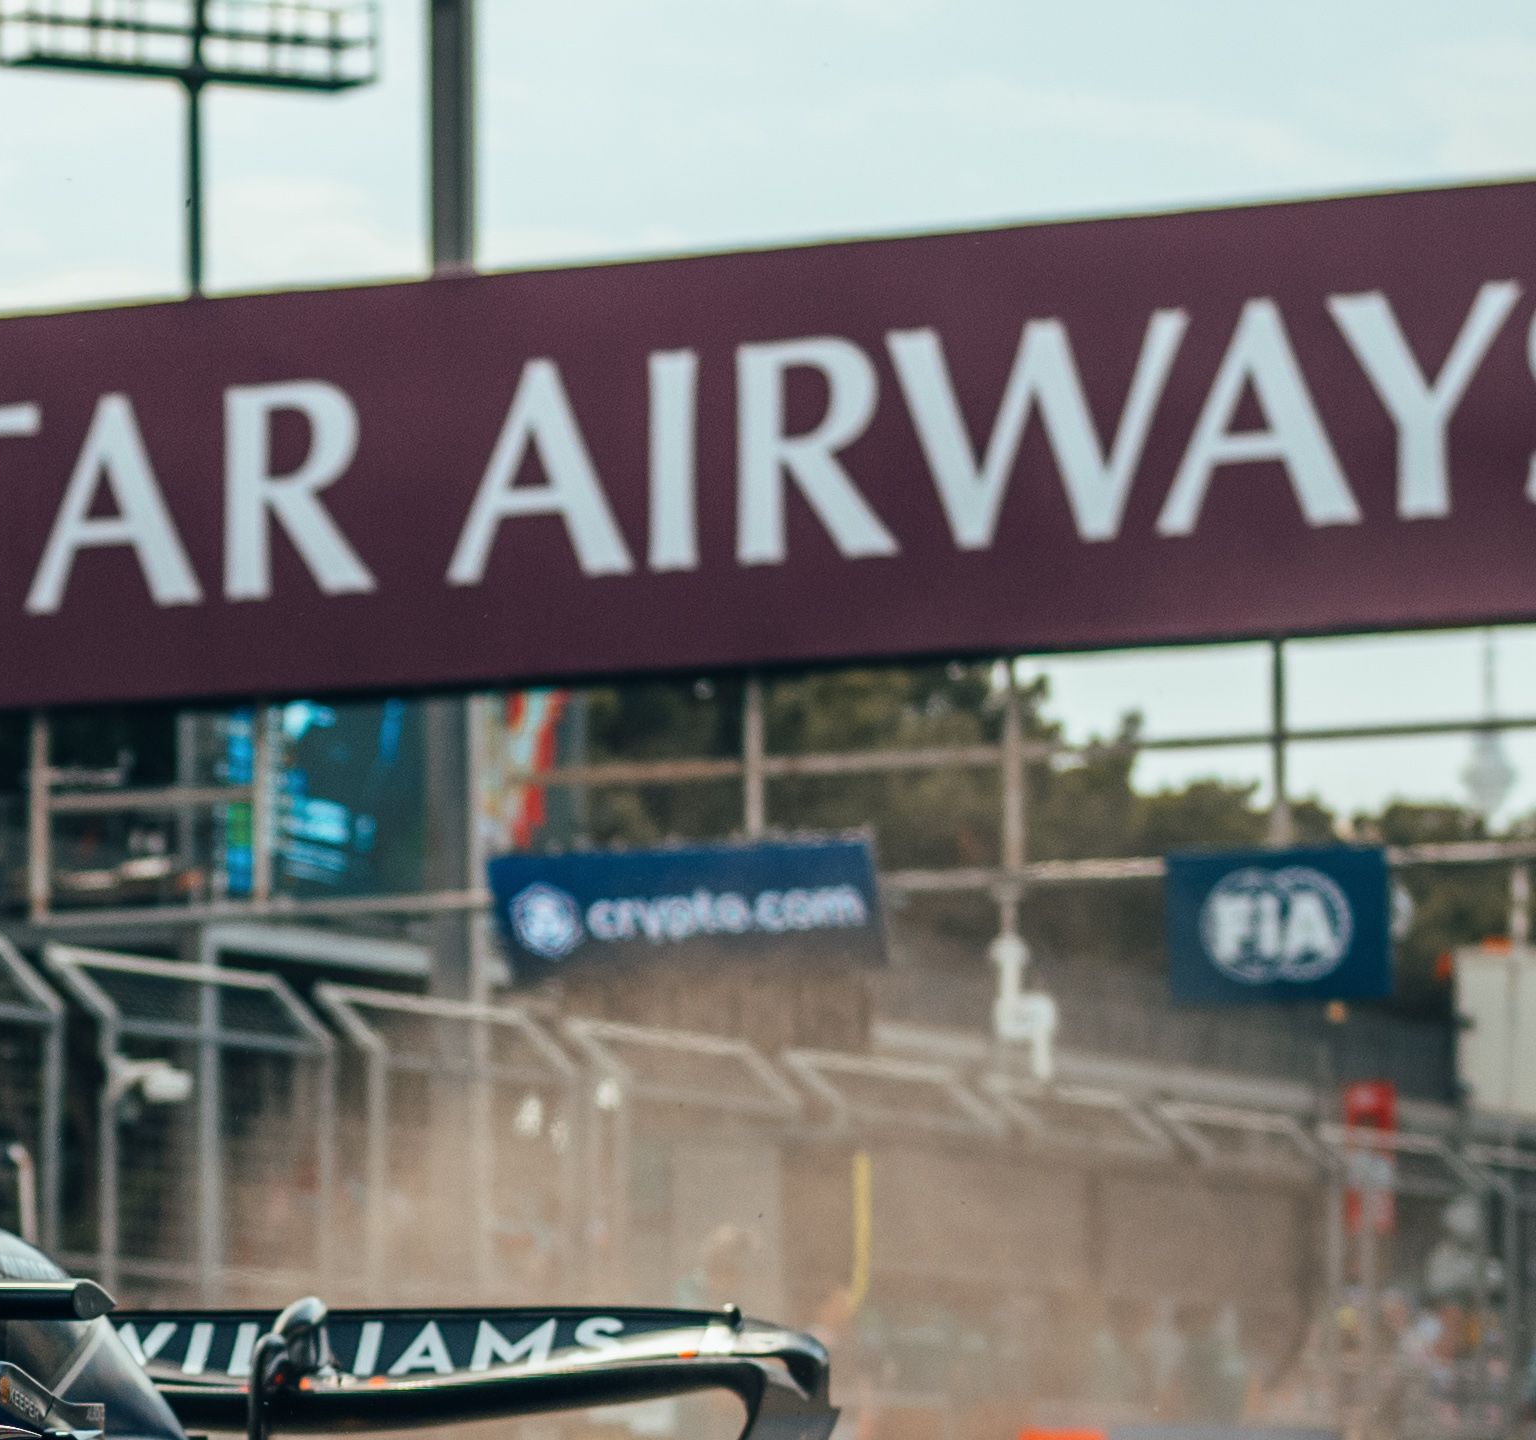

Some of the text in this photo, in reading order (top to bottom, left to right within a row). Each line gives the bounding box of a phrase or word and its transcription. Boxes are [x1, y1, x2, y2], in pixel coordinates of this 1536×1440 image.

[444, 276, 1536, 586] AIRWAY
[1210, 891, 1339, 964] FIA
[9, 1388, 40, 1421] KEEPER
